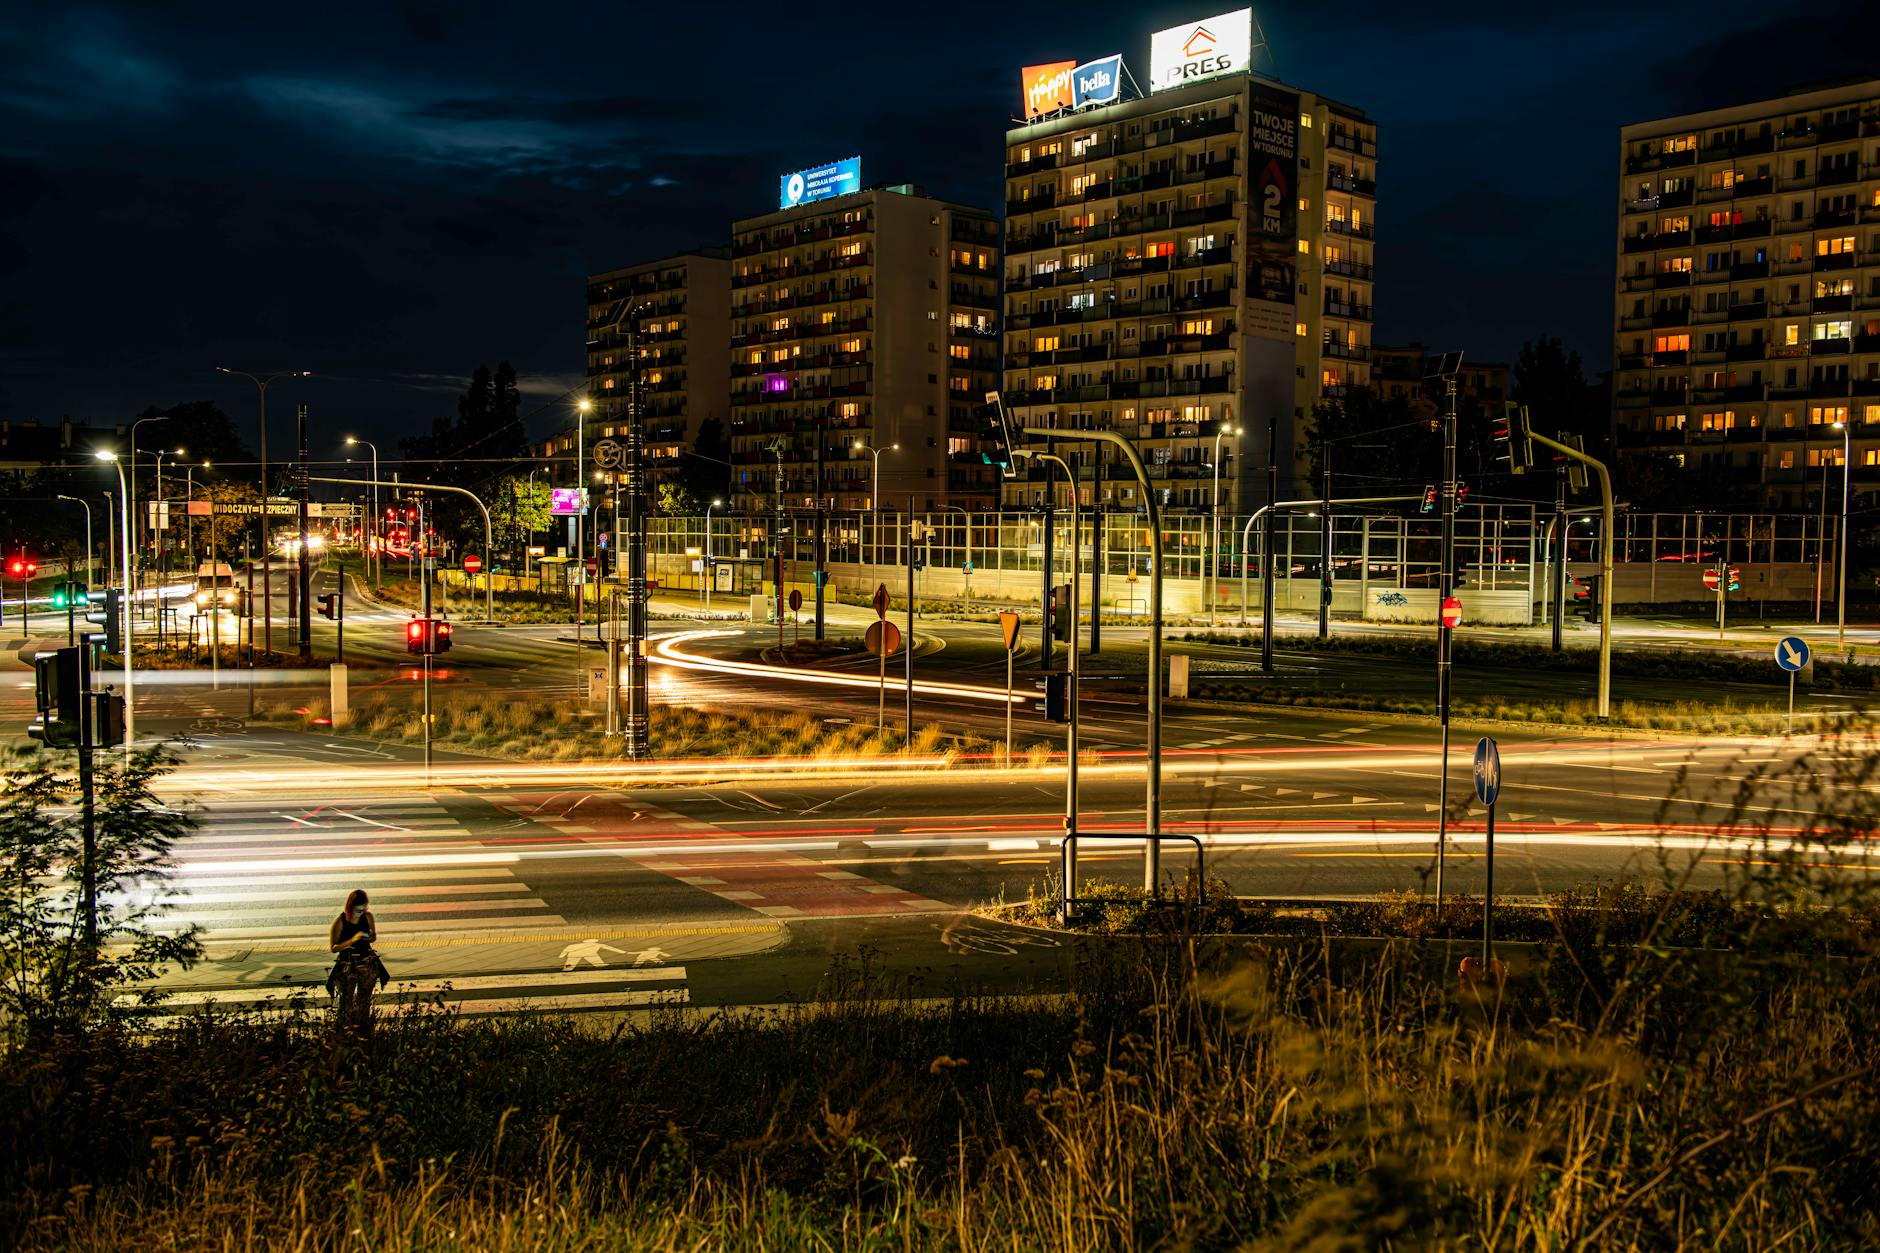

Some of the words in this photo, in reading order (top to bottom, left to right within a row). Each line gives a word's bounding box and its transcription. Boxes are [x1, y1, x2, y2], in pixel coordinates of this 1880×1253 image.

[1167, 54, 1232, 82] PRES
[1080, 70, 1110, 94] bella
[1253, 110, 1294, 133] TWOJE
[1253, 126, 1294, 148] MIEJSCE
[1253, 140, 1261, 151] W
[1262, 143, 1294, 159] TORUNIU
[1263, 184, 1281, 218] 2
[1263, 217, 1280, 234] KM
